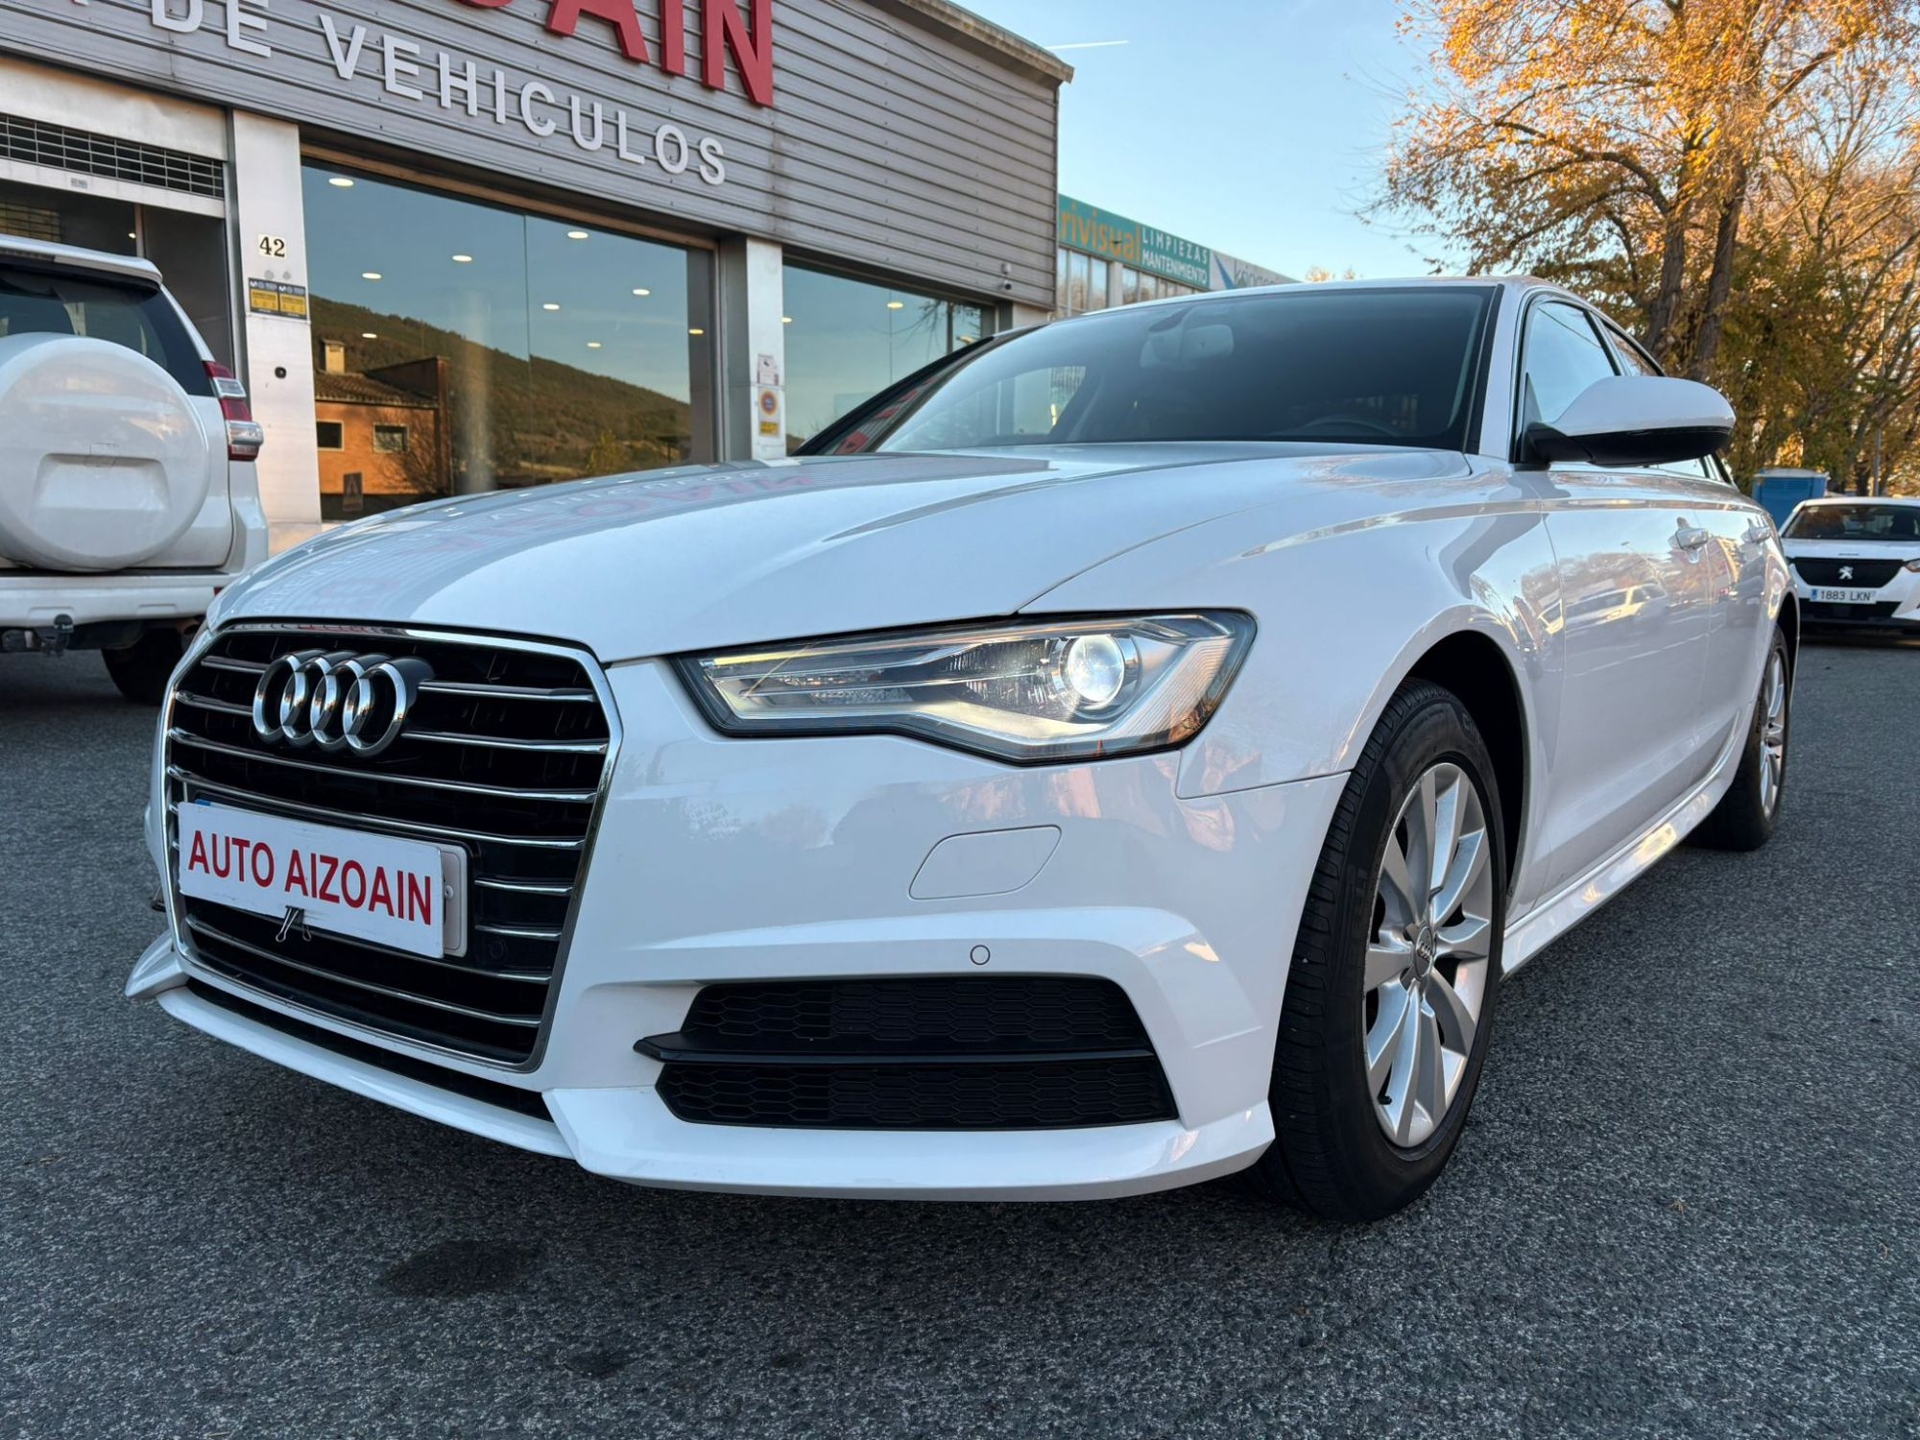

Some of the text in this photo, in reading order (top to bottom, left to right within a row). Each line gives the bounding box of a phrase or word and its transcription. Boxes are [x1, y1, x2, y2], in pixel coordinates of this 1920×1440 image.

[320, 14, 726, 186] VEHICULOS
[259, 236, 286, 258] 42
[1142, 226, 1208, 265] LIMPIEZAS
[1142, 248, 1208, 285] MANTENIMIENTO
[1820, 590, 1871, 601] 1883 LKN
[188, 830, 431, 926] AUTO AIZOAIN
